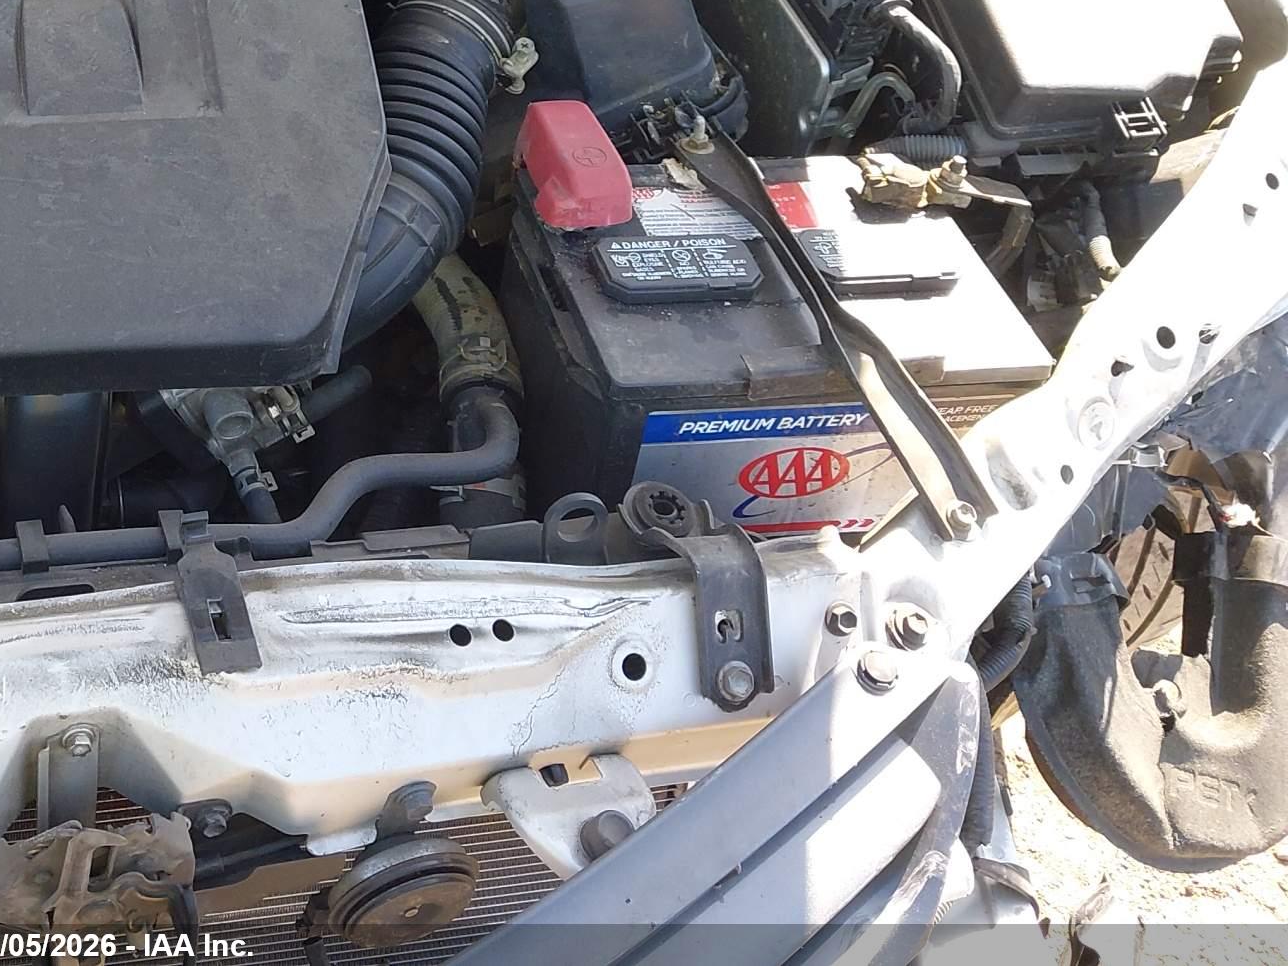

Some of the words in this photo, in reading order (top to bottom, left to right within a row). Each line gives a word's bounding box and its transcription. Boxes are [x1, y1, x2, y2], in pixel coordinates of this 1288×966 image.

[621, 240, 671, 249] DANGER
[682, 238, 726, 246] POISON
[678, 417, 776, 434] PREMIUM
[776, 413, 871, 430] BATTERY
[744, 447, 844, 498] AAA
